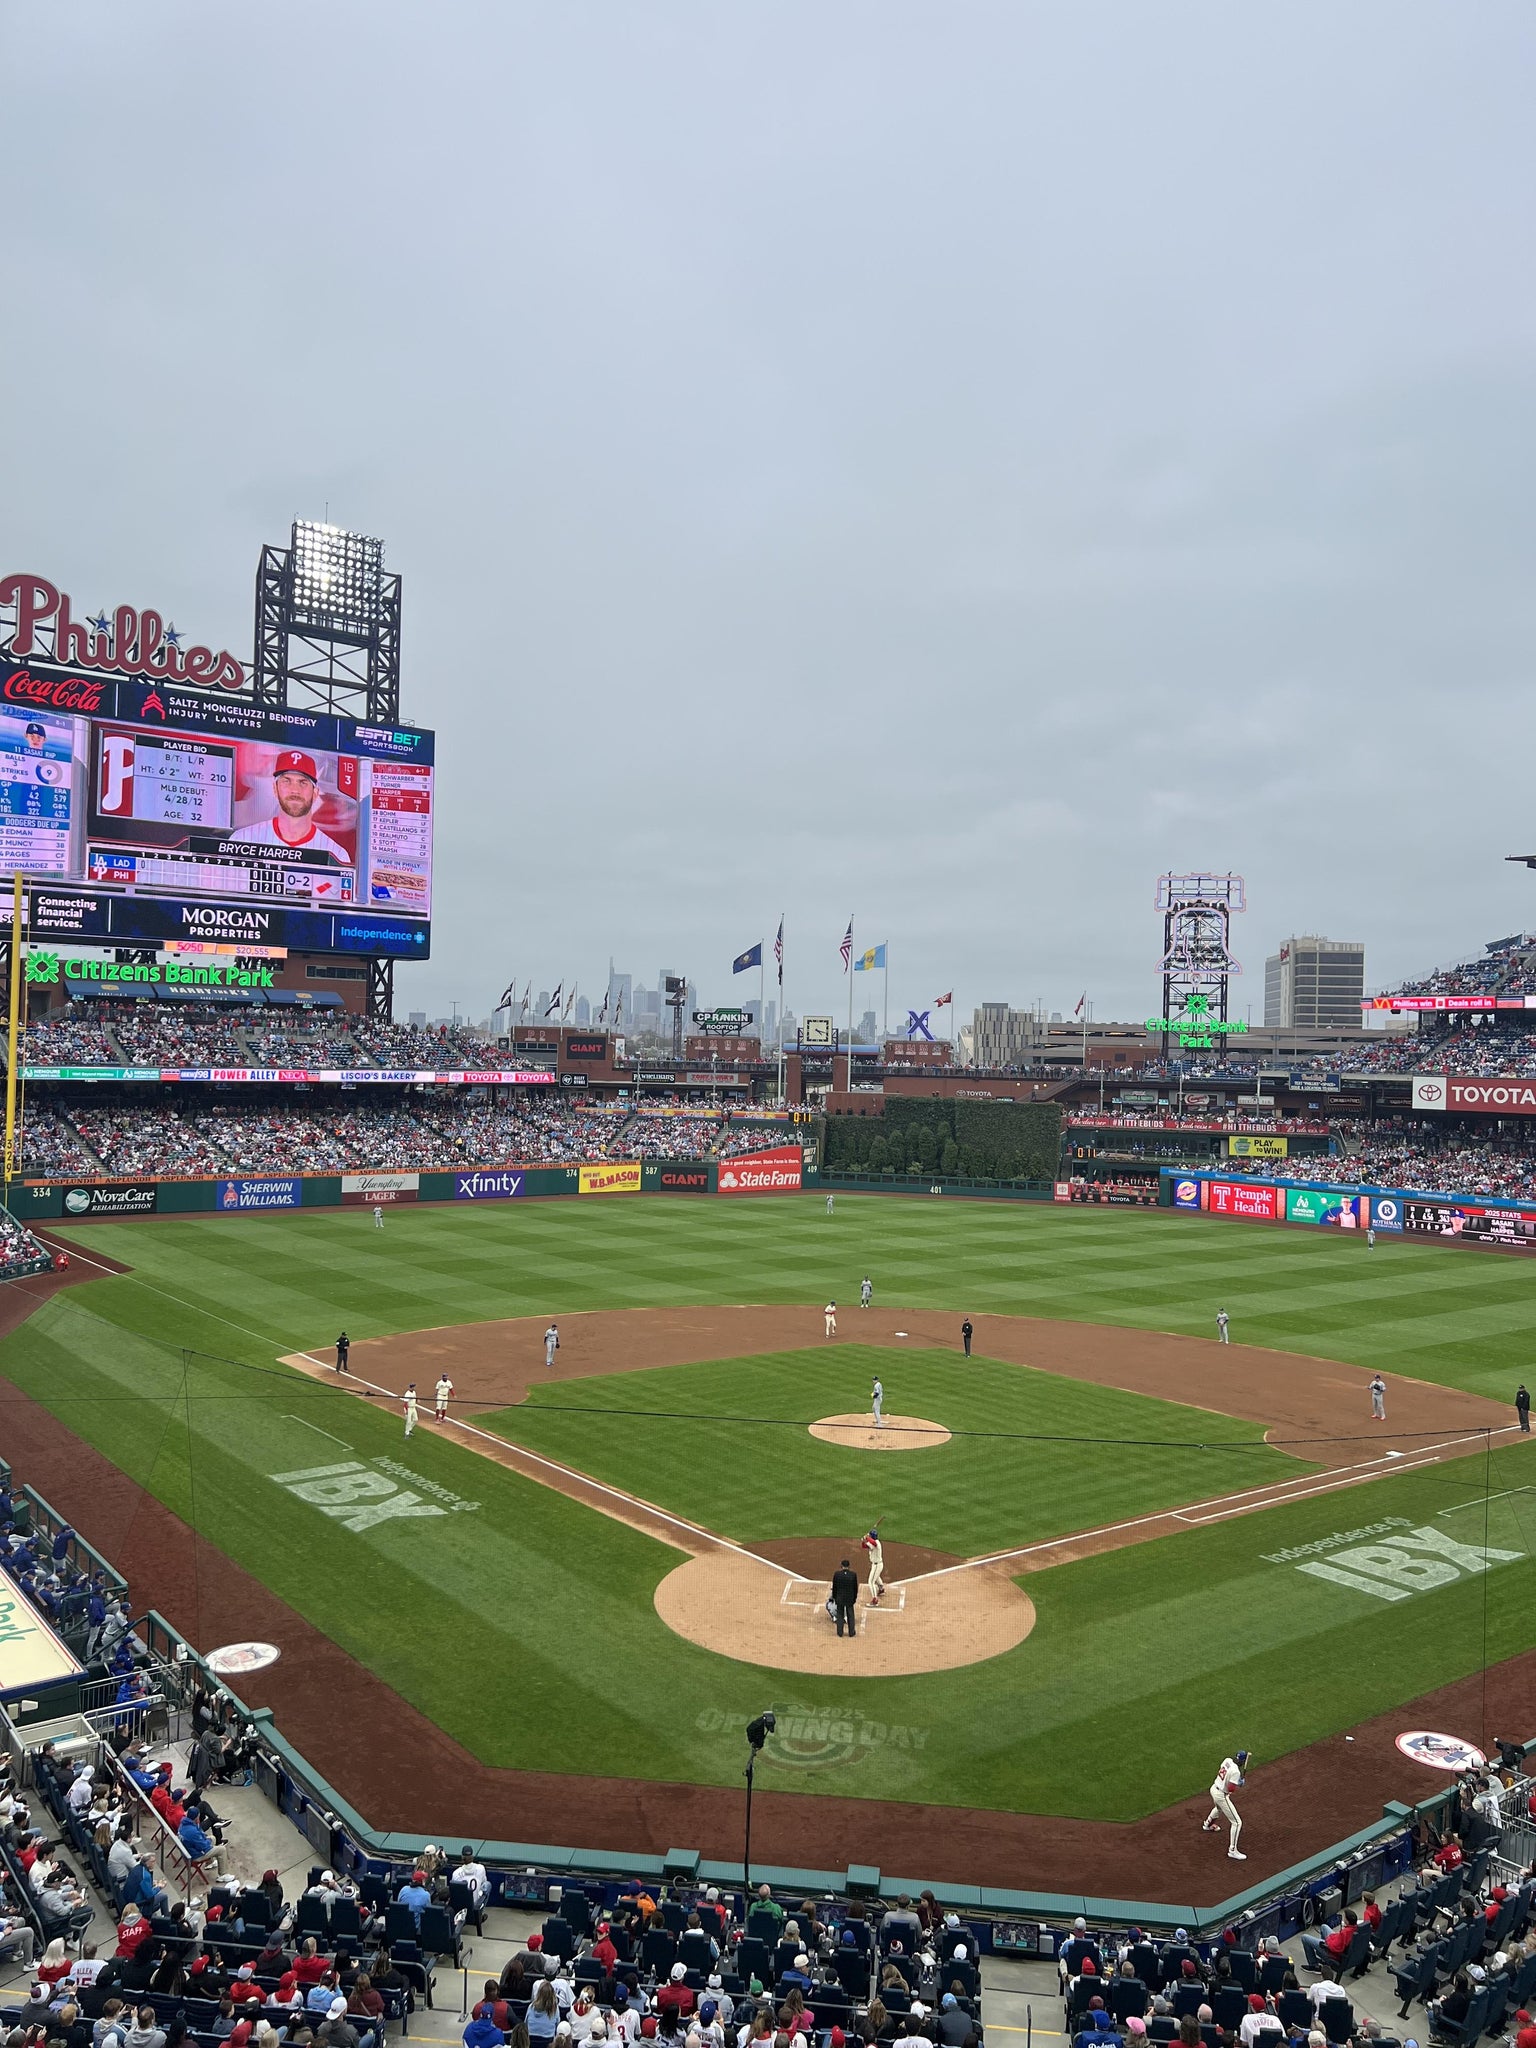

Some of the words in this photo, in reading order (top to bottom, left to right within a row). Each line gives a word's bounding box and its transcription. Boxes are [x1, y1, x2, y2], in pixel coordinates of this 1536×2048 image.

[0, 573, 246, 690] Phillies
[4, 671, 106, 711] Coca-Cola
[169, 697, 199, 709] SALTZ
[203, 702, 265, 719] MONGELUZZI
[269, 712, 317, 727] BENDESKY
[169, 708, 208, 720] INJURY
[216, 715, 262, 728] LAWYERS
[355, 726, 393, 742] ESPN
[393, 732, 421, 746] BET
[23, 747, 43, 757] SASAKI
[163, 741, 192, 752] PLAYER
[193, 745, 207, 754] BIO
[363, 740, 413, 753] SPORTSBOOK
[5, 754, 26, 762] BALLS
[165, 754, 182, 763] B/T:
[188, 756, 205, 766] L/R
[1, 767, 29, 776] STRIKES
[343, 762, 354, 773] 1B
[141, 766, 154, 774] HT:
[188, 771, 204, 780] WT:
[210, 774, 226, 783] 210
[345, 775, 352, 785] 3
[380, 774, 415, 782] SCHWARBER
[160, 784, 177, 793] MLB
[180, 786, 208, 797] DEBUT:
[165, 795, 203, 806] 4/28/12
[164, 811, 184, 820] AGE:
[191, 813, 202, 822] 32
[5, 818, 36, 828] DODGERS
[37, 820, 49, 829] DUE
[51, 821, 60, 829] UP
[379, 825, 418, 833] CASTELLANOS
[6, 828, 33, 836] EDMAN
[379, 831, 408, 840] REALMUTO
[218, 843, 256, 856] BRYCE
[258, 847, 302, 860] HARPER
[113, 859, 130, 868] LAD
[114, 871, 129, 879] PHI
[288, 875, 310, 887] 0-2
[38, 896, 97, 911] Connecting
[37, 906, 83, 918] financial
[182, 907, 269, 929] MORGAN
[37, 917, 83, 929] services.
[189, 926, 262, 939] PROPERTIES
[341, 927, 412, 940] Independence
[236, 946, 269, 956] $20,555
[65, 959, 160, 982] Citizens
[165, 964, 222, 985] Bank
[226, 966, 274, 988] Park
[170, 986, 211, 995] HARRY
[229, 988, 249, 996] K'S
[1393, 999, 1418, 1007] Phillies
[1448, 999, 1469, 1007] Deals
[1470, 999, 1482, 1007] roll
[697, 1013, 711, 1021] CP
[712, 1013, 748, 1021] RANKIN
[907, 1010, 934, 1041] X
[1145, 1018, 1206, 1032] Citizens
[1209, 1019, 1248, 1033] Bank
[1180, 1034, 1213, 1048] Park
[570, 1044, 602, 1053] GIANT
[214, 1070, 247, 1080] POWER
[250, 1070, 276, 1080] ALLEY
[281, 1071, 305, 1080] NECA
[340, 1072, 378, 1080] LISCIO'S
[381, 1072, 416, 1080] BAKERY
[466, 1073, 499, 1081] TOYOTA
[517, 1073, 550, 1081] TOYOTA
[1452, 1086, 1536, 1105] TOYOTA
[1223, 1123, 1277, 1132] #HITTHEBUDS
[1254, 1139, 1273, 1147] PLAY
[1264, 1146, 1282, 1155] WIN!
[566, 1168, 577, 1178] 374
[645, 1166, 657, 1175] 387
[105, 1176, 151, 1184] ASPLUNDH
[356, 1175, 406, 1190] Yuengling
[459, 1172, 521, 1197] xfinity
[589, 1170, 639, 1189] W.B.MASON
[662, 1173, 707, 1185] GIANT
[33, 1187, 51, 1198] 334
[241, 1181, 293, 1194] SHERWIN
[930, 1186, 942, 1194] 401
[91, 1188, 155, 1203] NovaCare
[239, 1194, 295, 1206] WILLIAMS.
[365, 1191, 396, 1201] LAGER
[1214, 1186, 1231, 1209] T
[1234, 1188, 1272, 1202] Temple
[91, 1203, 152, 1211] REHABILITATION
[1234, 1201, 1270, 1214] Health
[1384, 1205, 1393, 1214] R
[1485, 1209, 1500, 1217] 2025
[1501, 1211, 1521, 1219] STATS
[1491, 1219, 1514, 1227] SASAKI
[1491, 1227, 1515, 1235] HARPER
[1512, 1238, 1527, 1246] Speed
[370, 1456, 461, 1503] Independence
[267, 1461, 449, 1532] IBX
[1258, 1521, 1393, 1564] Independence
[1294, 1526, 1526, 1601] IBX
[818, 1706, 865, 1720] 2025
[695, 1707, 854, 1743] OPNING
[861, 1721, 929, 1750] DAY
[122, 1927, 143, 1939] STAFF
